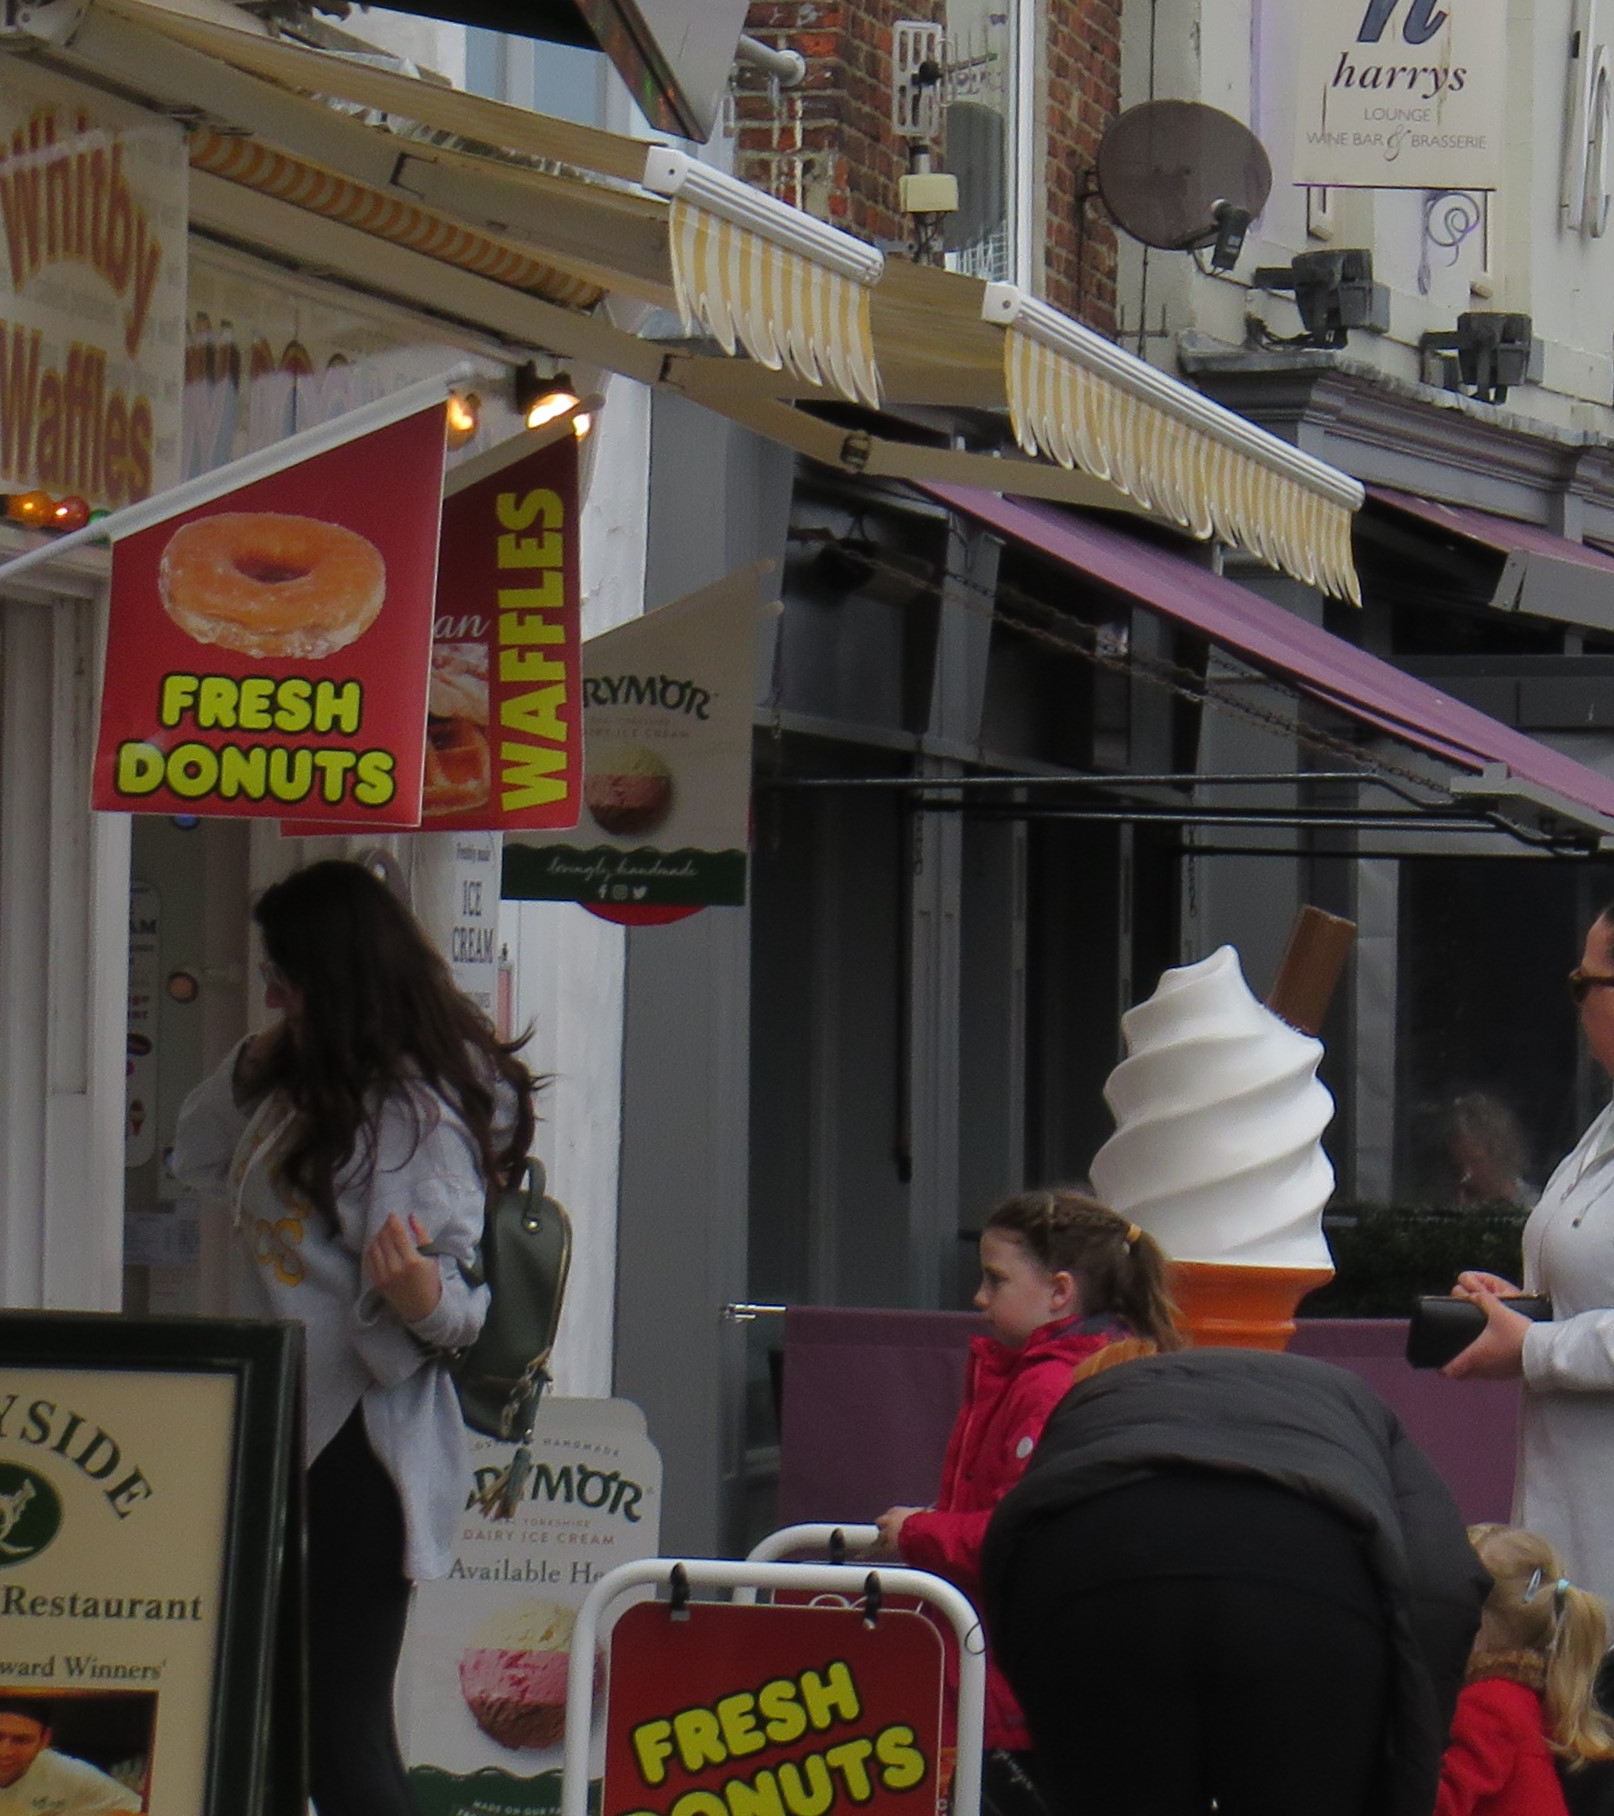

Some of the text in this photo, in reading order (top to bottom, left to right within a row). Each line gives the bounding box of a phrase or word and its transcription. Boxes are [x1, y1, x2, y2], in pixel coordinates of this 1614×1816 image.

[1331, 51, 1467, 100] harrys
[1363, 107, 1431, 123] LOUNGE
[1306, 131, 1347, 146] WINE
[1352, 132, 1384, 147] BAR
[1411, 135, 1487, 150] BRASSERIE
[0, 317, 155, 510] Waffles
[496, 487, 569, 813] WAFFLES
[160, 673, 363, 735] FRESH
[583, 674, 713, 721] RYMOR
[116, 741, 396, 808] DONUTS
[463, 1528, 615, 1545] DAIRY ICE CREAM
[448, 1557, 561, 1583] Available
[1, 1585, 203, 1621] Restaurant
[0, 1655, 56, 1678] ward
[632, 1659, 862, 1786] FRESH
[613, 1724, 928, 1816] NUTS
